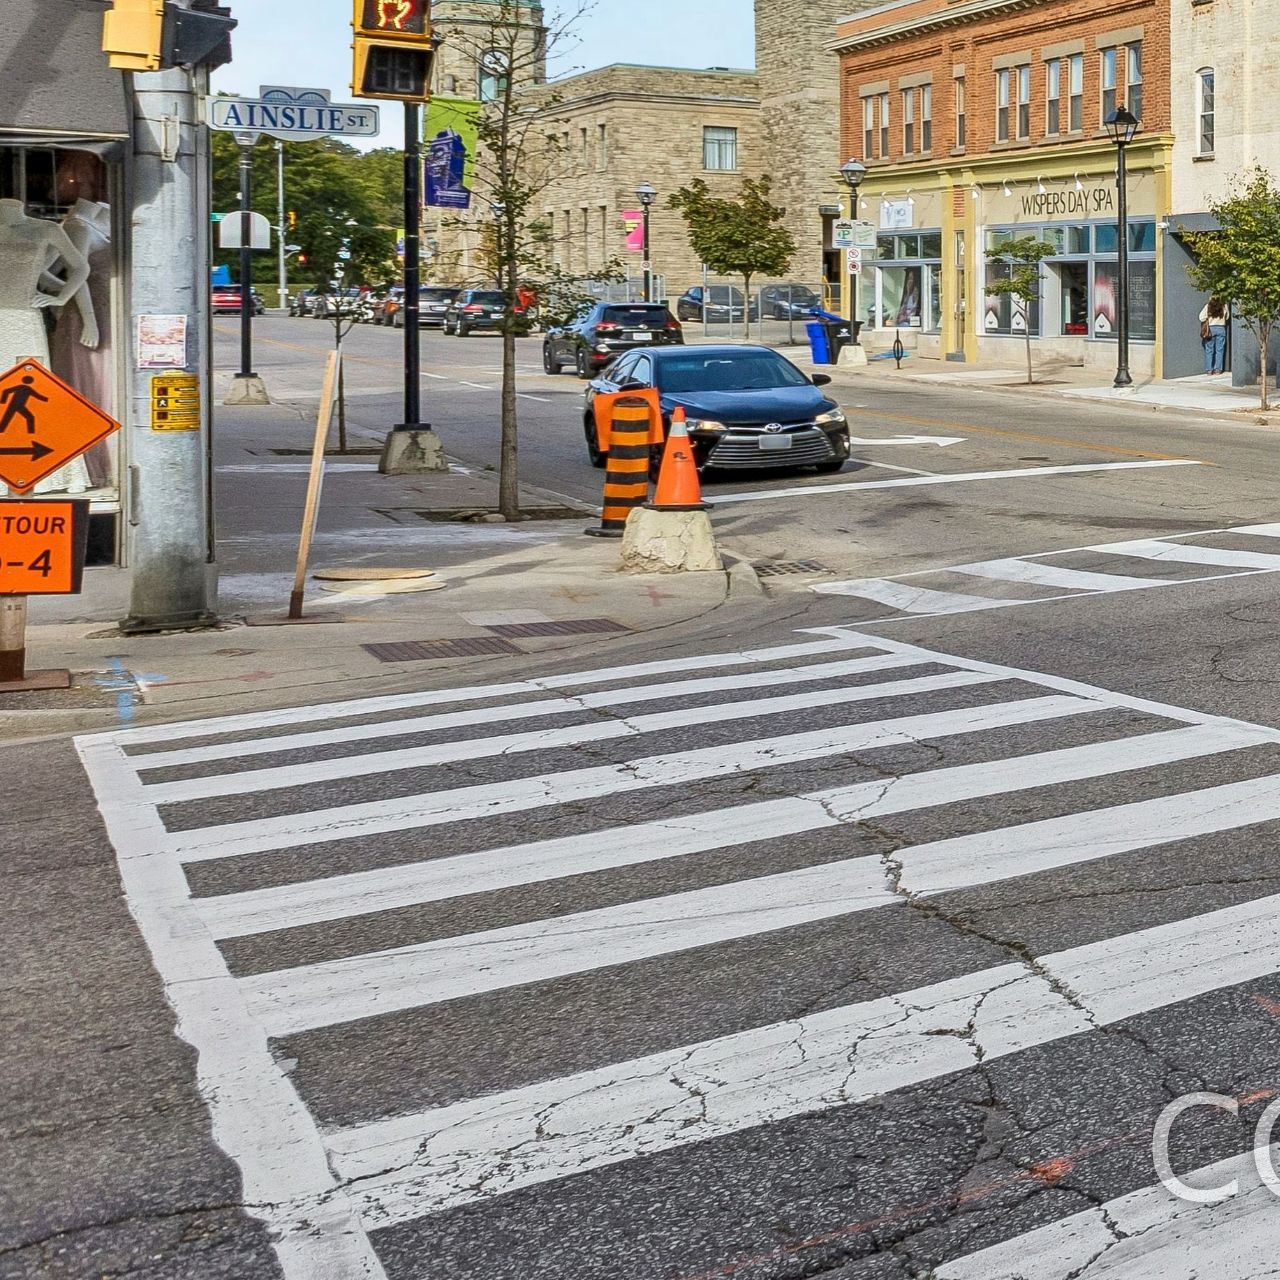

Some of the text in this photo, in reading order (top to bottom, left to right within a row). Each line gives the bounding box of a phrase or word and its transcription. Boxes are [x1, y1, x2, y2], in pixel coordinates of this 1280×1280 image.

[223, 104, 369, 131] AINSLIE ST.
[1021, 188, 1113, 216] WISPERS DAY SPA
[0, 516, 65, 535] TOUR
[0, 549, 52, 577] -4
